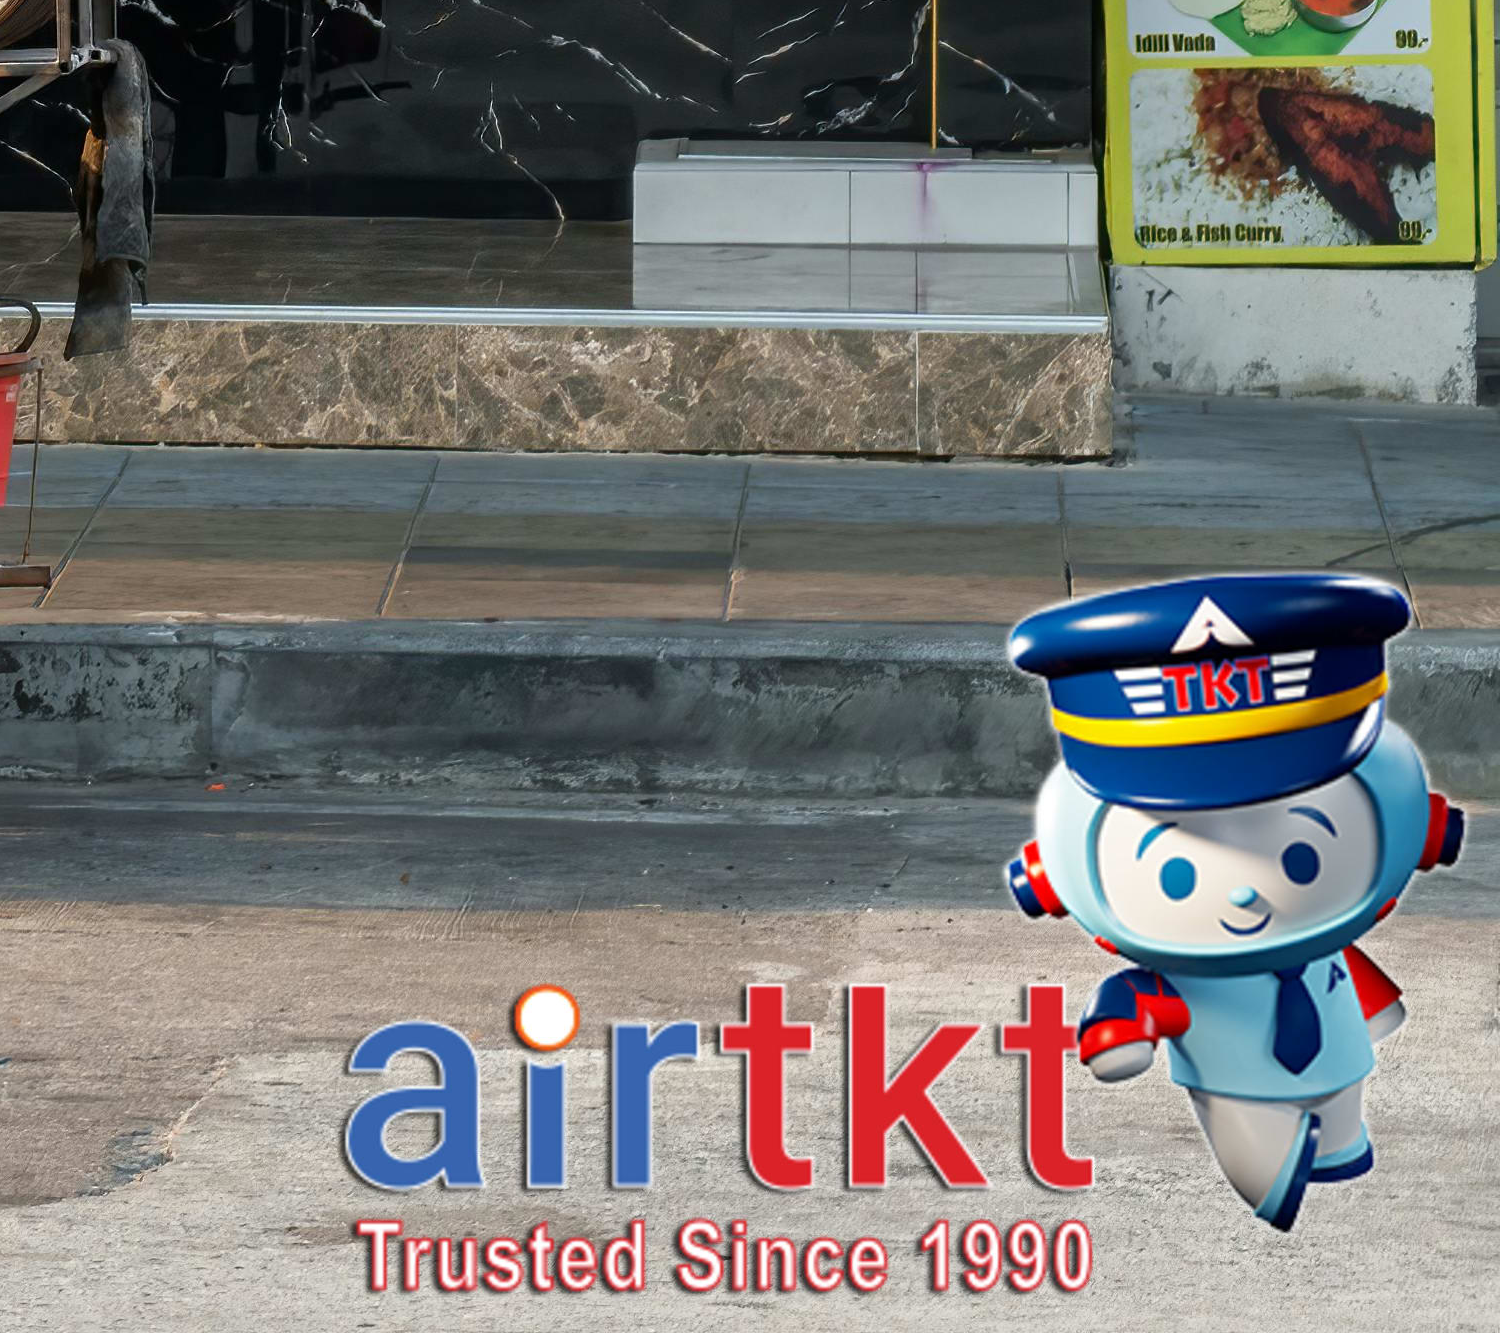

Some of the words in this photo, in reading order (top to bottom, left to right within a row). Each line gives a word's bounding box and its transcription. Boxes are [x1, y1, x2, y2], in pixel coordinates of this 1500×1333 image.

[1140, 224, 1177, 244] Rice
[1180, 226, 1194, 243] &
[1196, 224, 1231, 244] Fish
